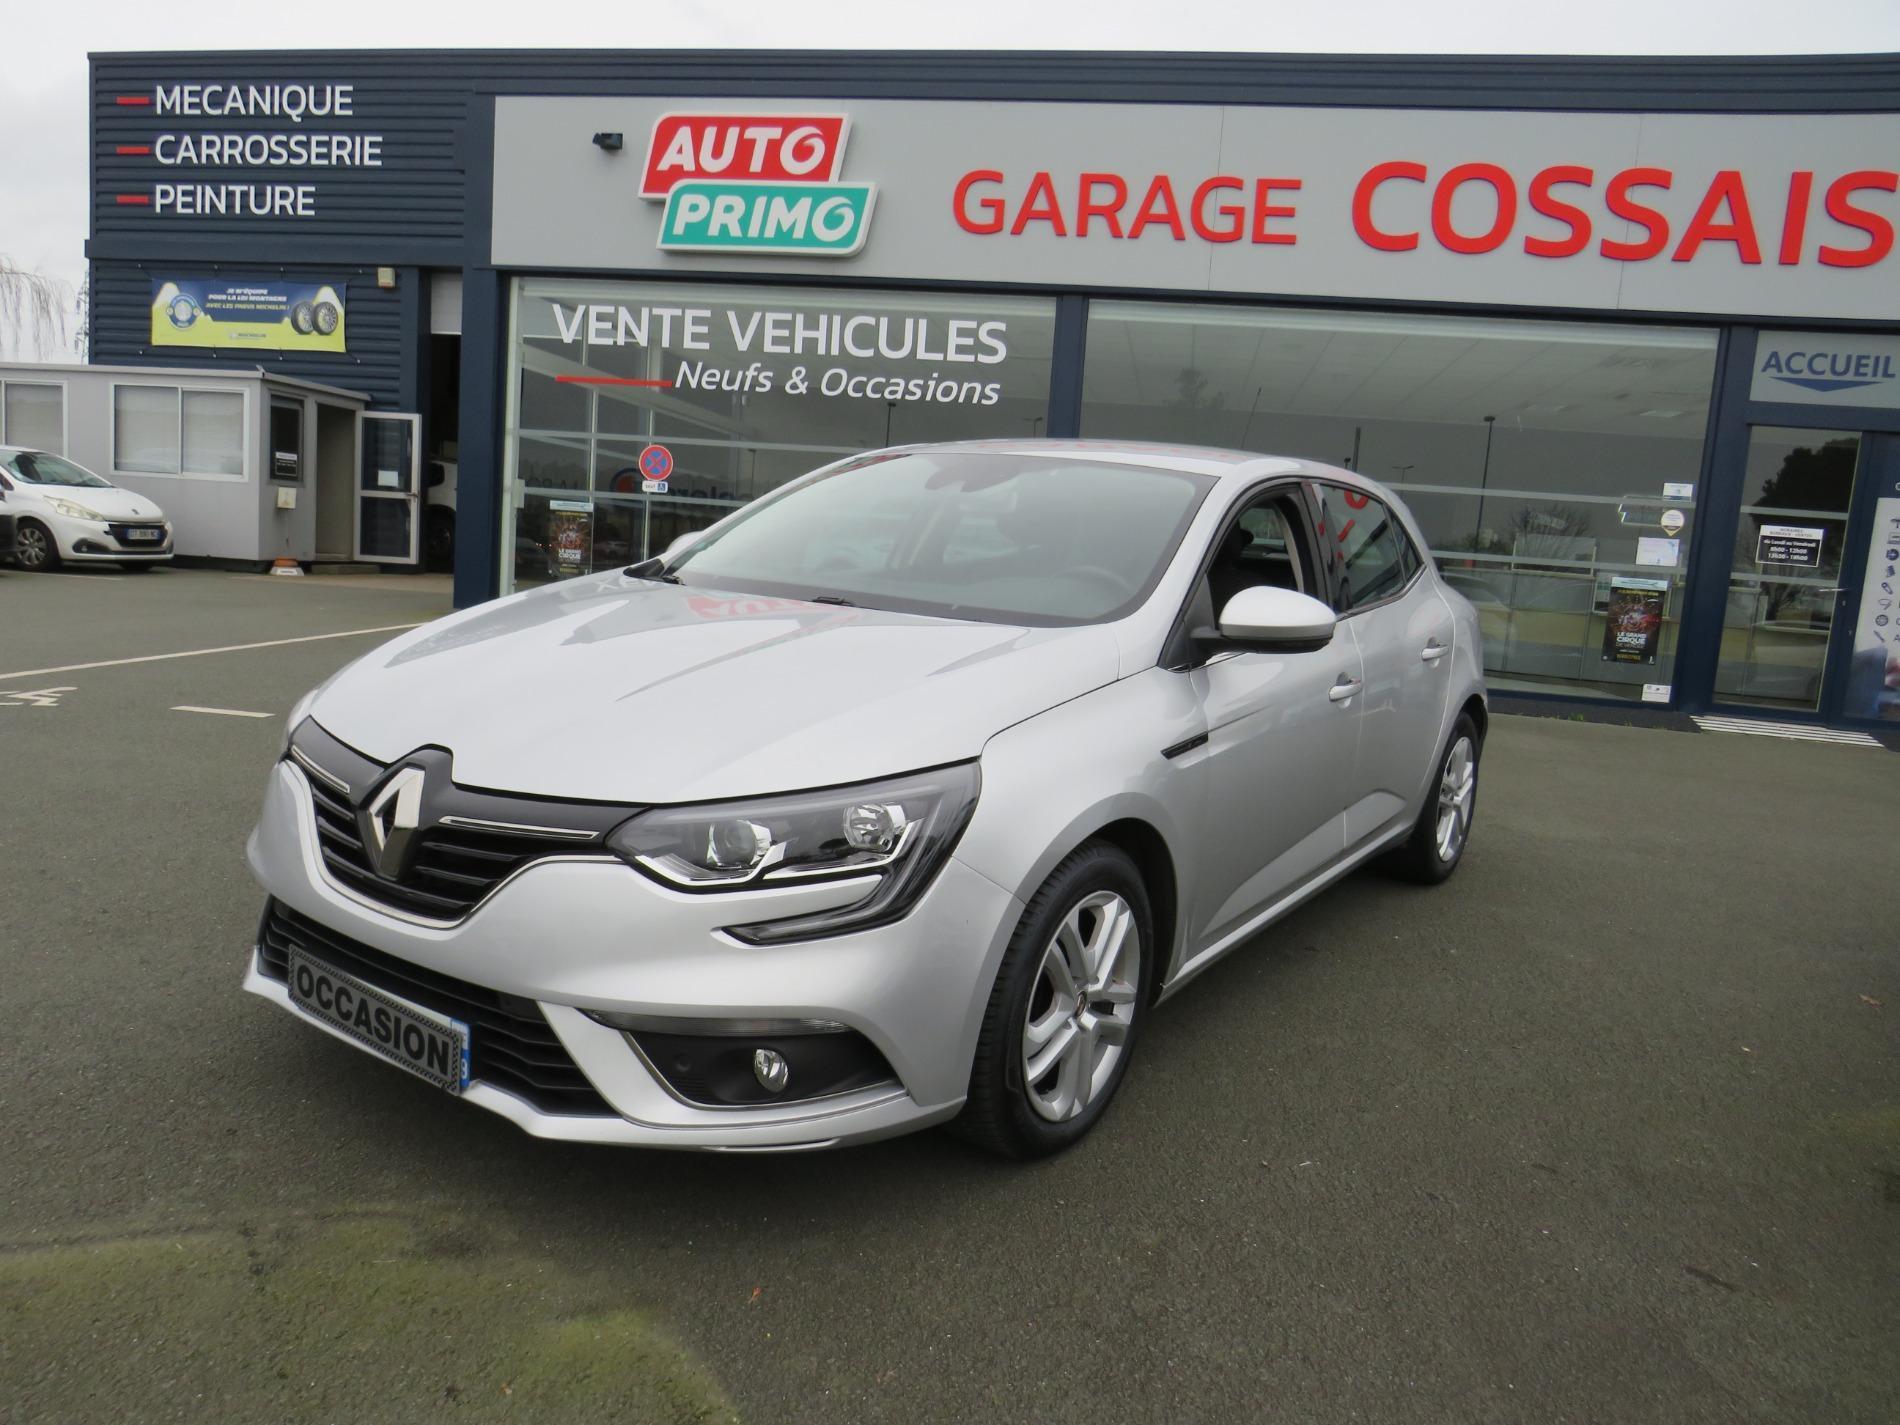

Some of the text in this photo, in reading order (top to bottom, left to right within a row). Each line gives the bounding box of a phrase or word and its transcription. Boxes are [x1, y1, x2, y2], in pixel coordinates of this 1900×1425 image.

[156, 85, 353, 122] MECANIQUE
[155, 135, 383, 166] CARROSSERIE
[656, 126, 825, 175] AUTO
[155, 184, 316, 216] PEINTURE
[672, 194, 855, 242] PRIMO
[952, 161, 1898, 267] GARAGE COSSAIS
[552, 303, 1007, 364] VENTE VEHICULES
[675, 361, 1001, 404] Neufs & Occasions
[1761, 351, 1896, 378] ACCUEIL
[297, 964, 450, 1076] OCCASION
